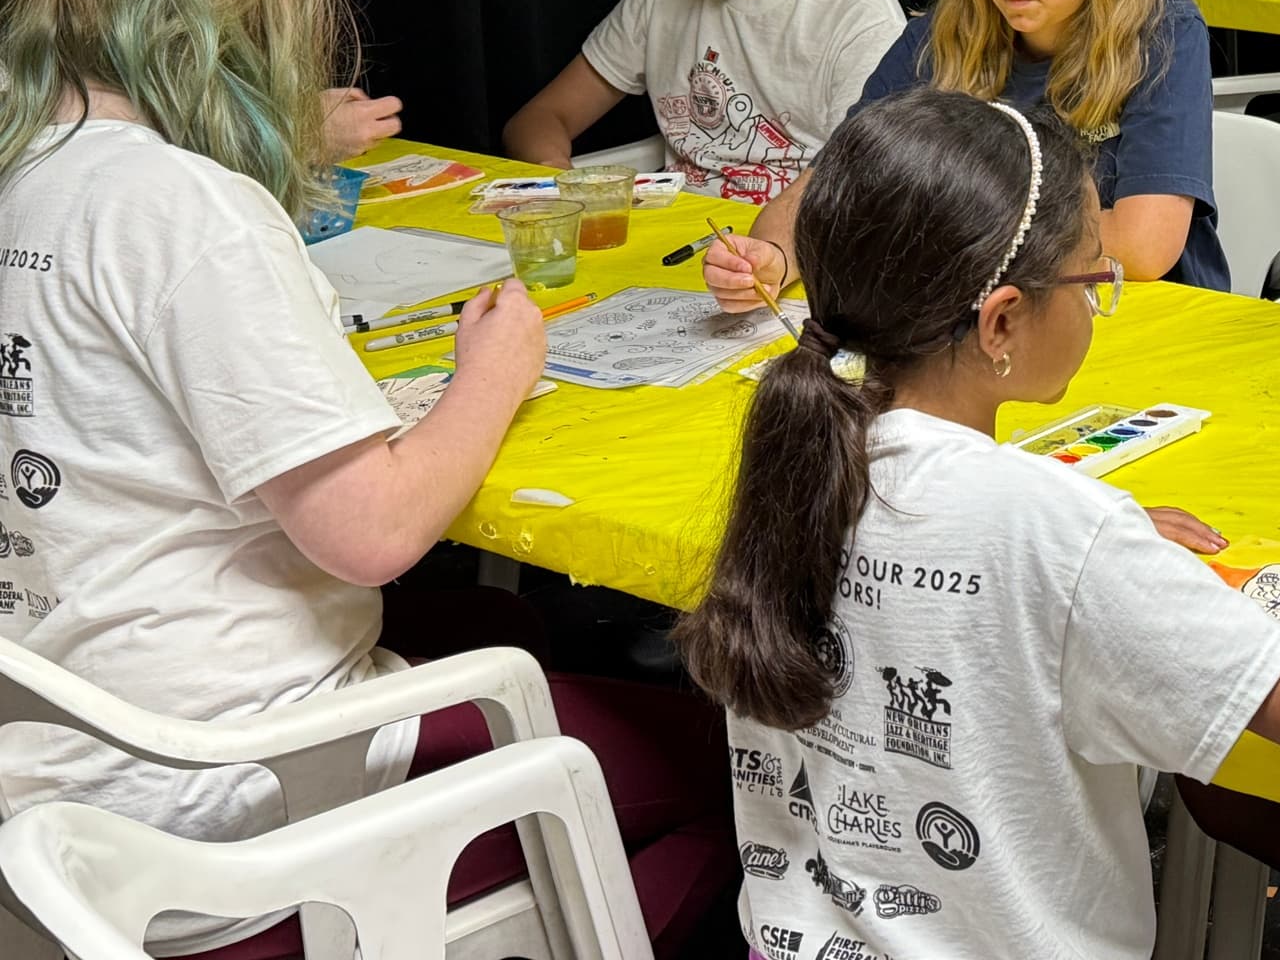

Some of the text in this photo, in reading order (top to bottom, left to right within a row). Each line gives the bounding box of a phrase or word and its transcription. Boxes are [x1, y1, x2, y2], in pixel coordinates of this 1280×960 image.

[9, 249, 52, 272] 2025
[857, 555, 903, 586] OUR
[913, 567, 981, 595] 2025
[0, 601, 15, 610] ANK
[838, 725, 876, 746] CULTURAL
[886, 710, 948, 737] NEW ORLEANS
[886, 724, 903, 737] JAZZ
[912, 730, 948, 751] HERITAGE
[736, 781, 774, 796] NCIL
[839, 784, 890, 817] LAKE
[827, 804, 902, 844] CHARLES
[760, 925, 789, 950] CSE
[833, 937, 865, 952] FIRST
